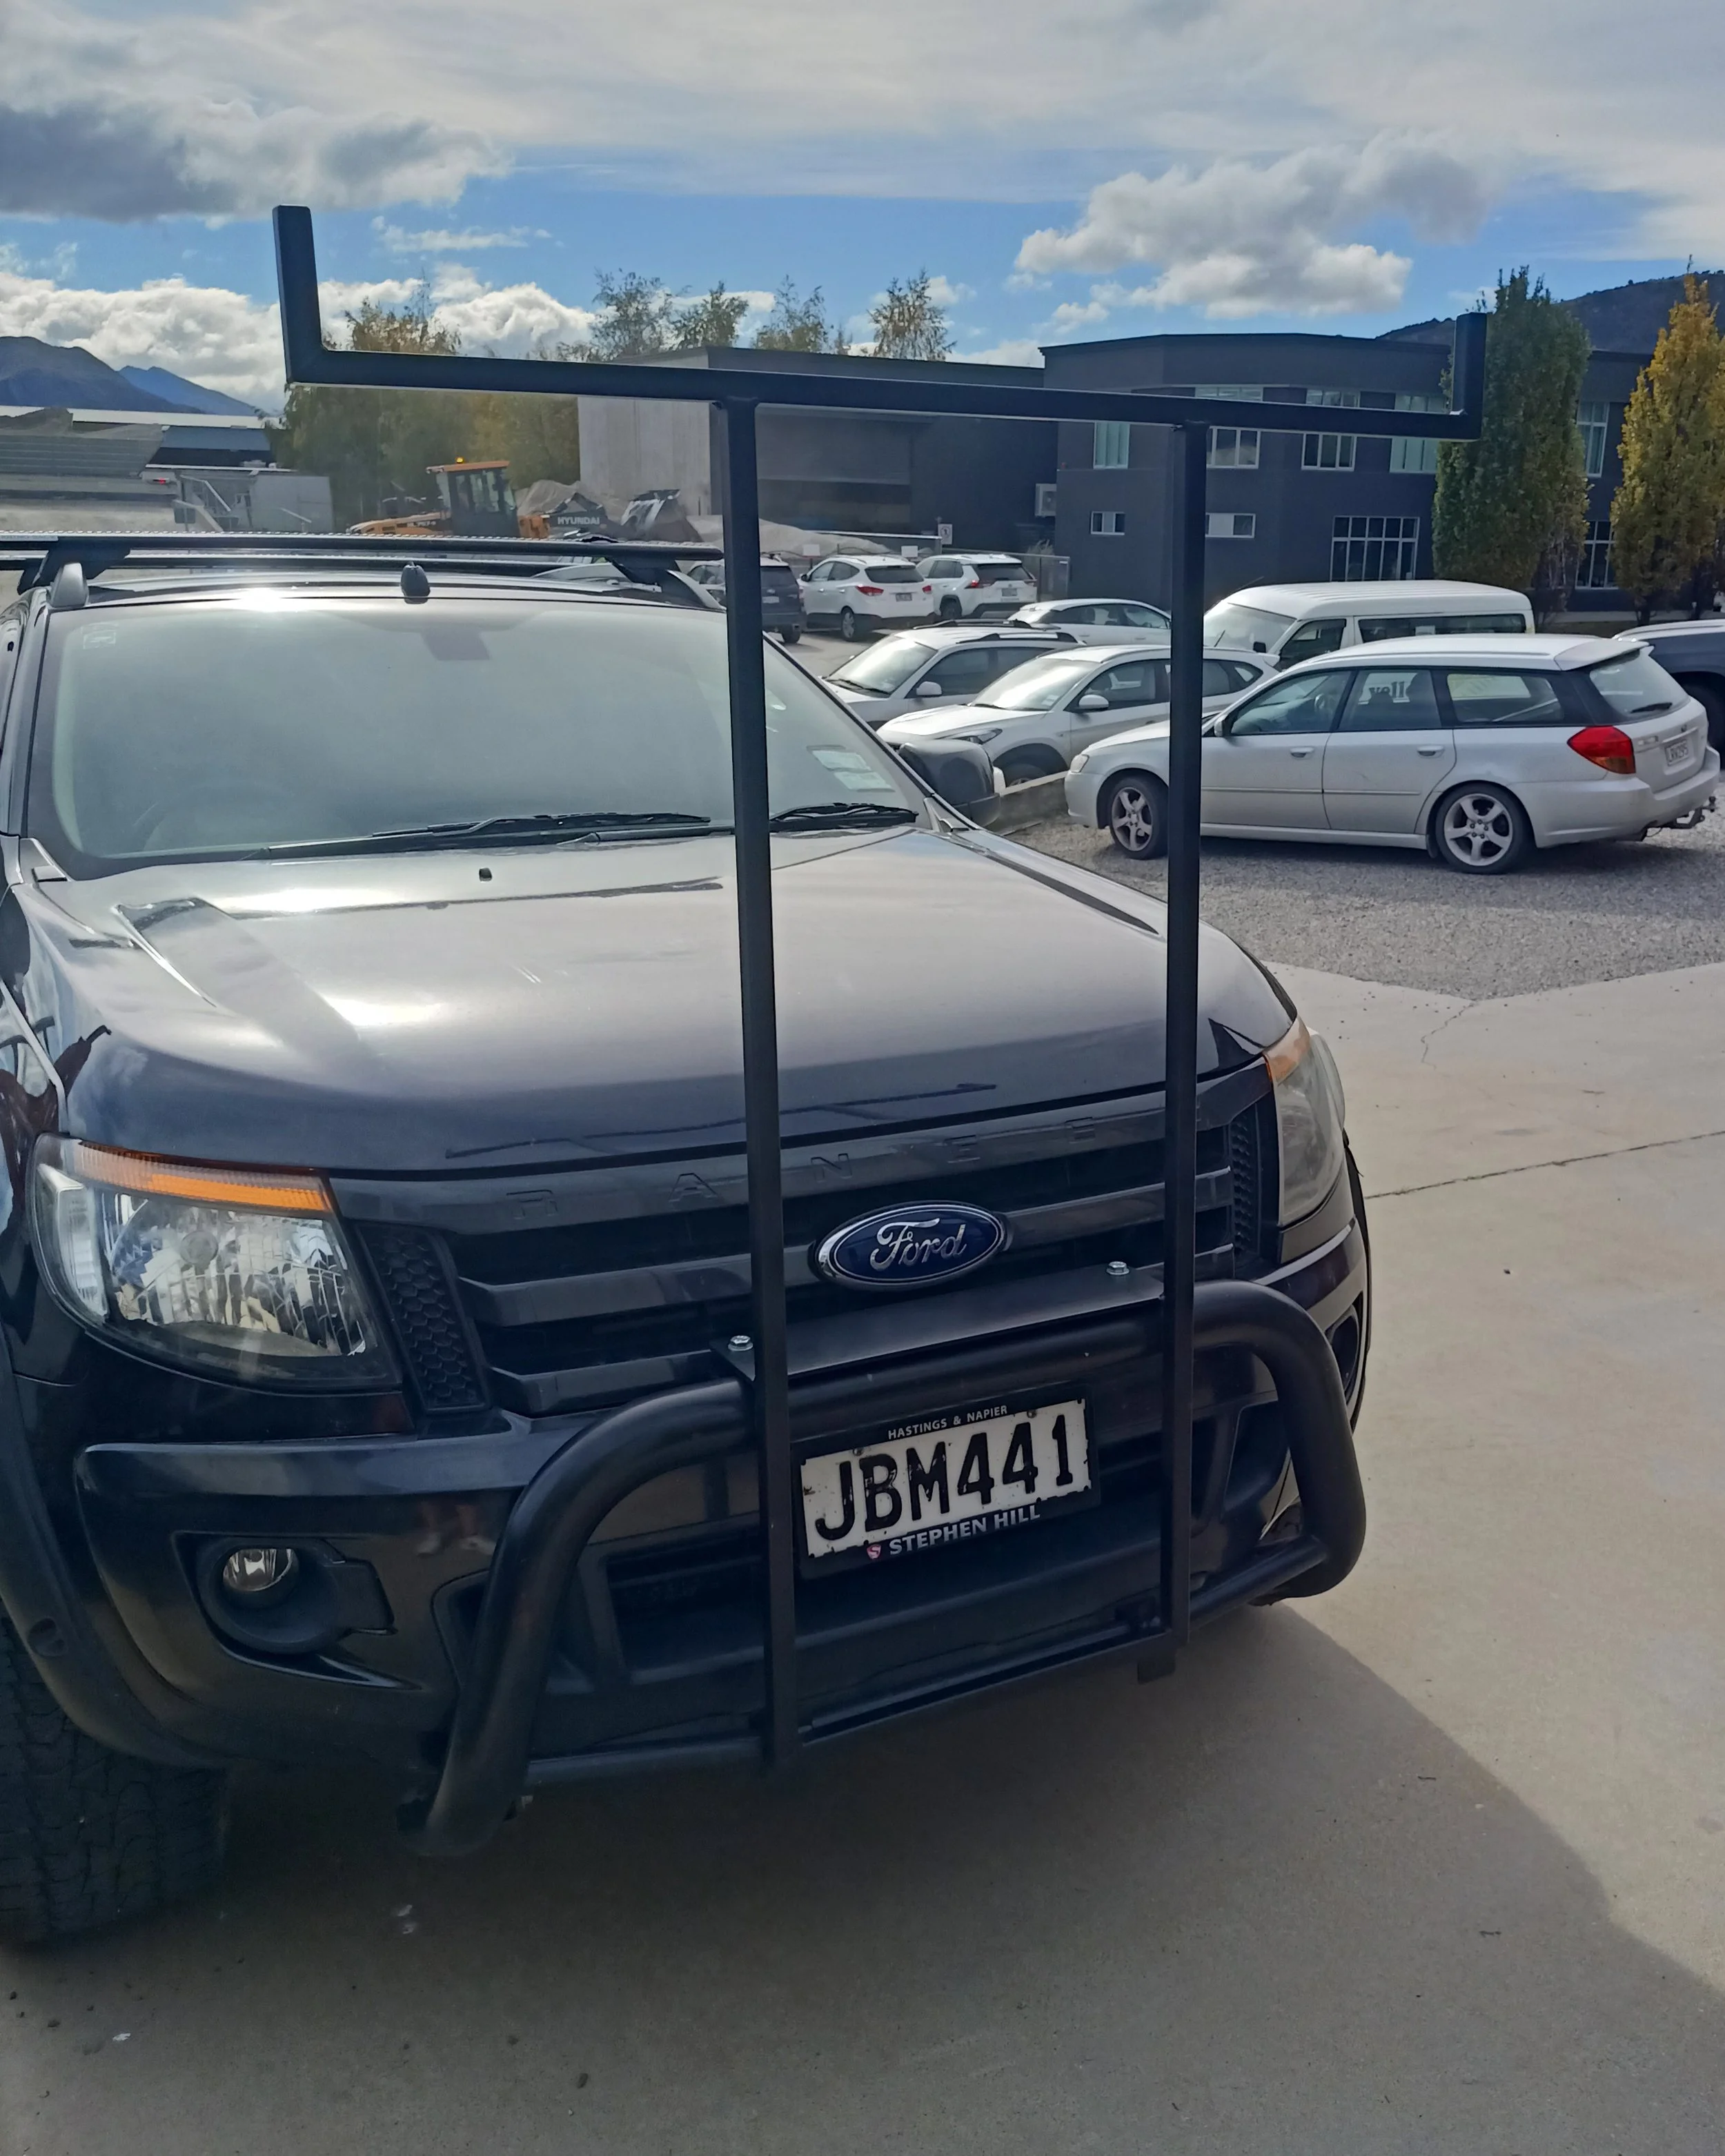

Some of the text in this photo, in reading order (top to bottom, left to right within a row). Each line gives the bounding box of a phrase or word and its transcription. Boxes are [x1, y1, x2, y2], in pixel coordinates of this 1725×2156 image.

[557, 516, 600, 525] HYUNDAI
[870, 1218, 967, 1271] Ford
[888, 1405, 1008, 1440] HASTINGS & NAPIER
[815, 1415, 1073, 1540] JBM441
[889, 1517, 987, 1555] STEPHEN
[994, 1505, 1041, 1530] HILL
